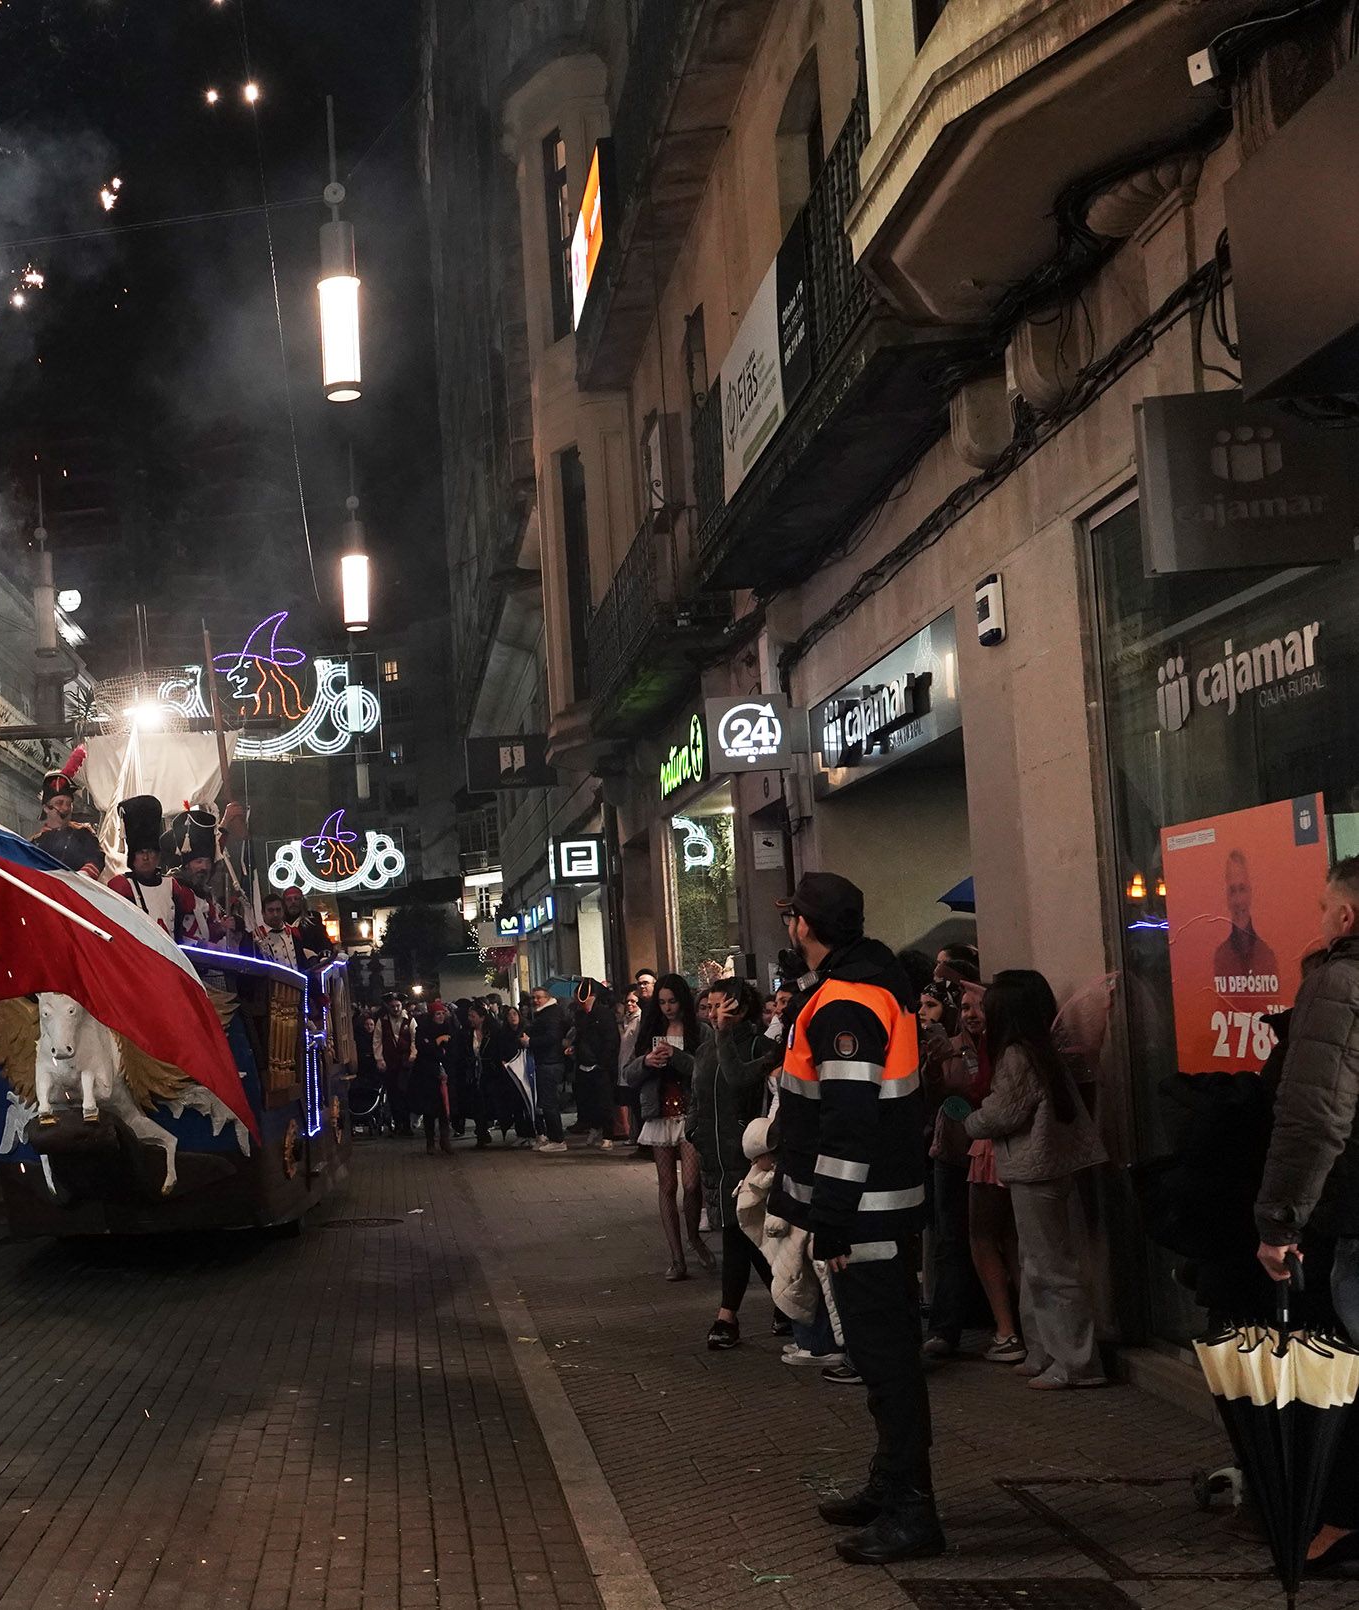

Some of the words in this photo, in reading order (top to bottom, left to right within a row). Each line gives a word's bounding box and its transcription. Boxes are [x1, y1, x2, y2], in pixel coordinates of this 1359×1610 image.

[1196, 621, 1320, 716] cajamar
[1259, 685, 1287, 708] CAJA
[1288, 671, 1325, 699] RURAL
[730, 717, 775, 748] 24
[844, 673, 914, 756] cajamar
[1214, 976, 1227, 993] TU
[1229, 969, 1278, 992] DEPÓSITO
[1211, 1010, 1279, 1061] 2'78
